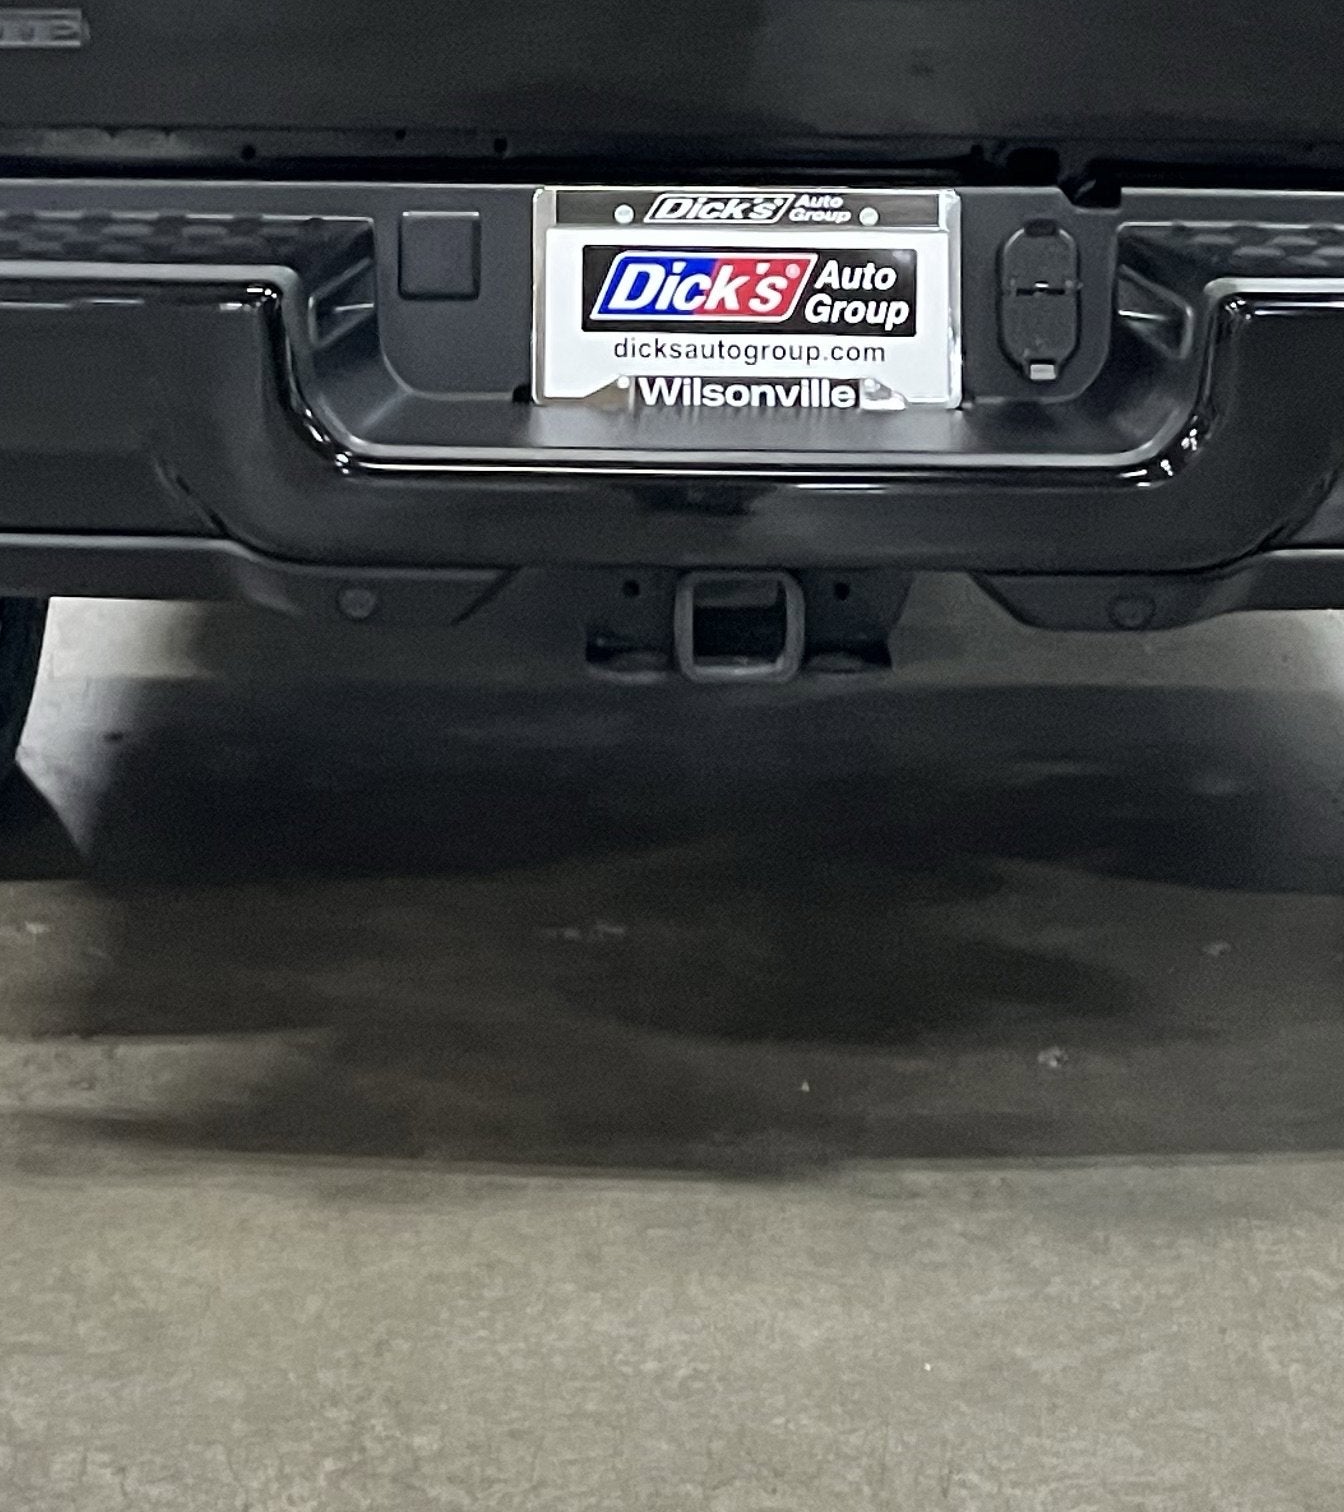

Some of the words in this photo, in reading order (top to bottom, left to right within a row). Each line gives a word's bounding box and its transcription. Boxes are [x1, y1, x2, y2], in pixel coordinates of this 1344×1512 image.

[654, 197, 775, 220] Dick's
[789, 208, 852, 224] Group
[795, 194, 844, 209] Auto
[607, 261, 789, 313] Dick's
[814, 259, 897, 291] Auto
[804, 293, 910, 332] Group
[613, 337, 887, 366] dicksautogroup.com
[637, 376, 856, 409] Wilsonville
